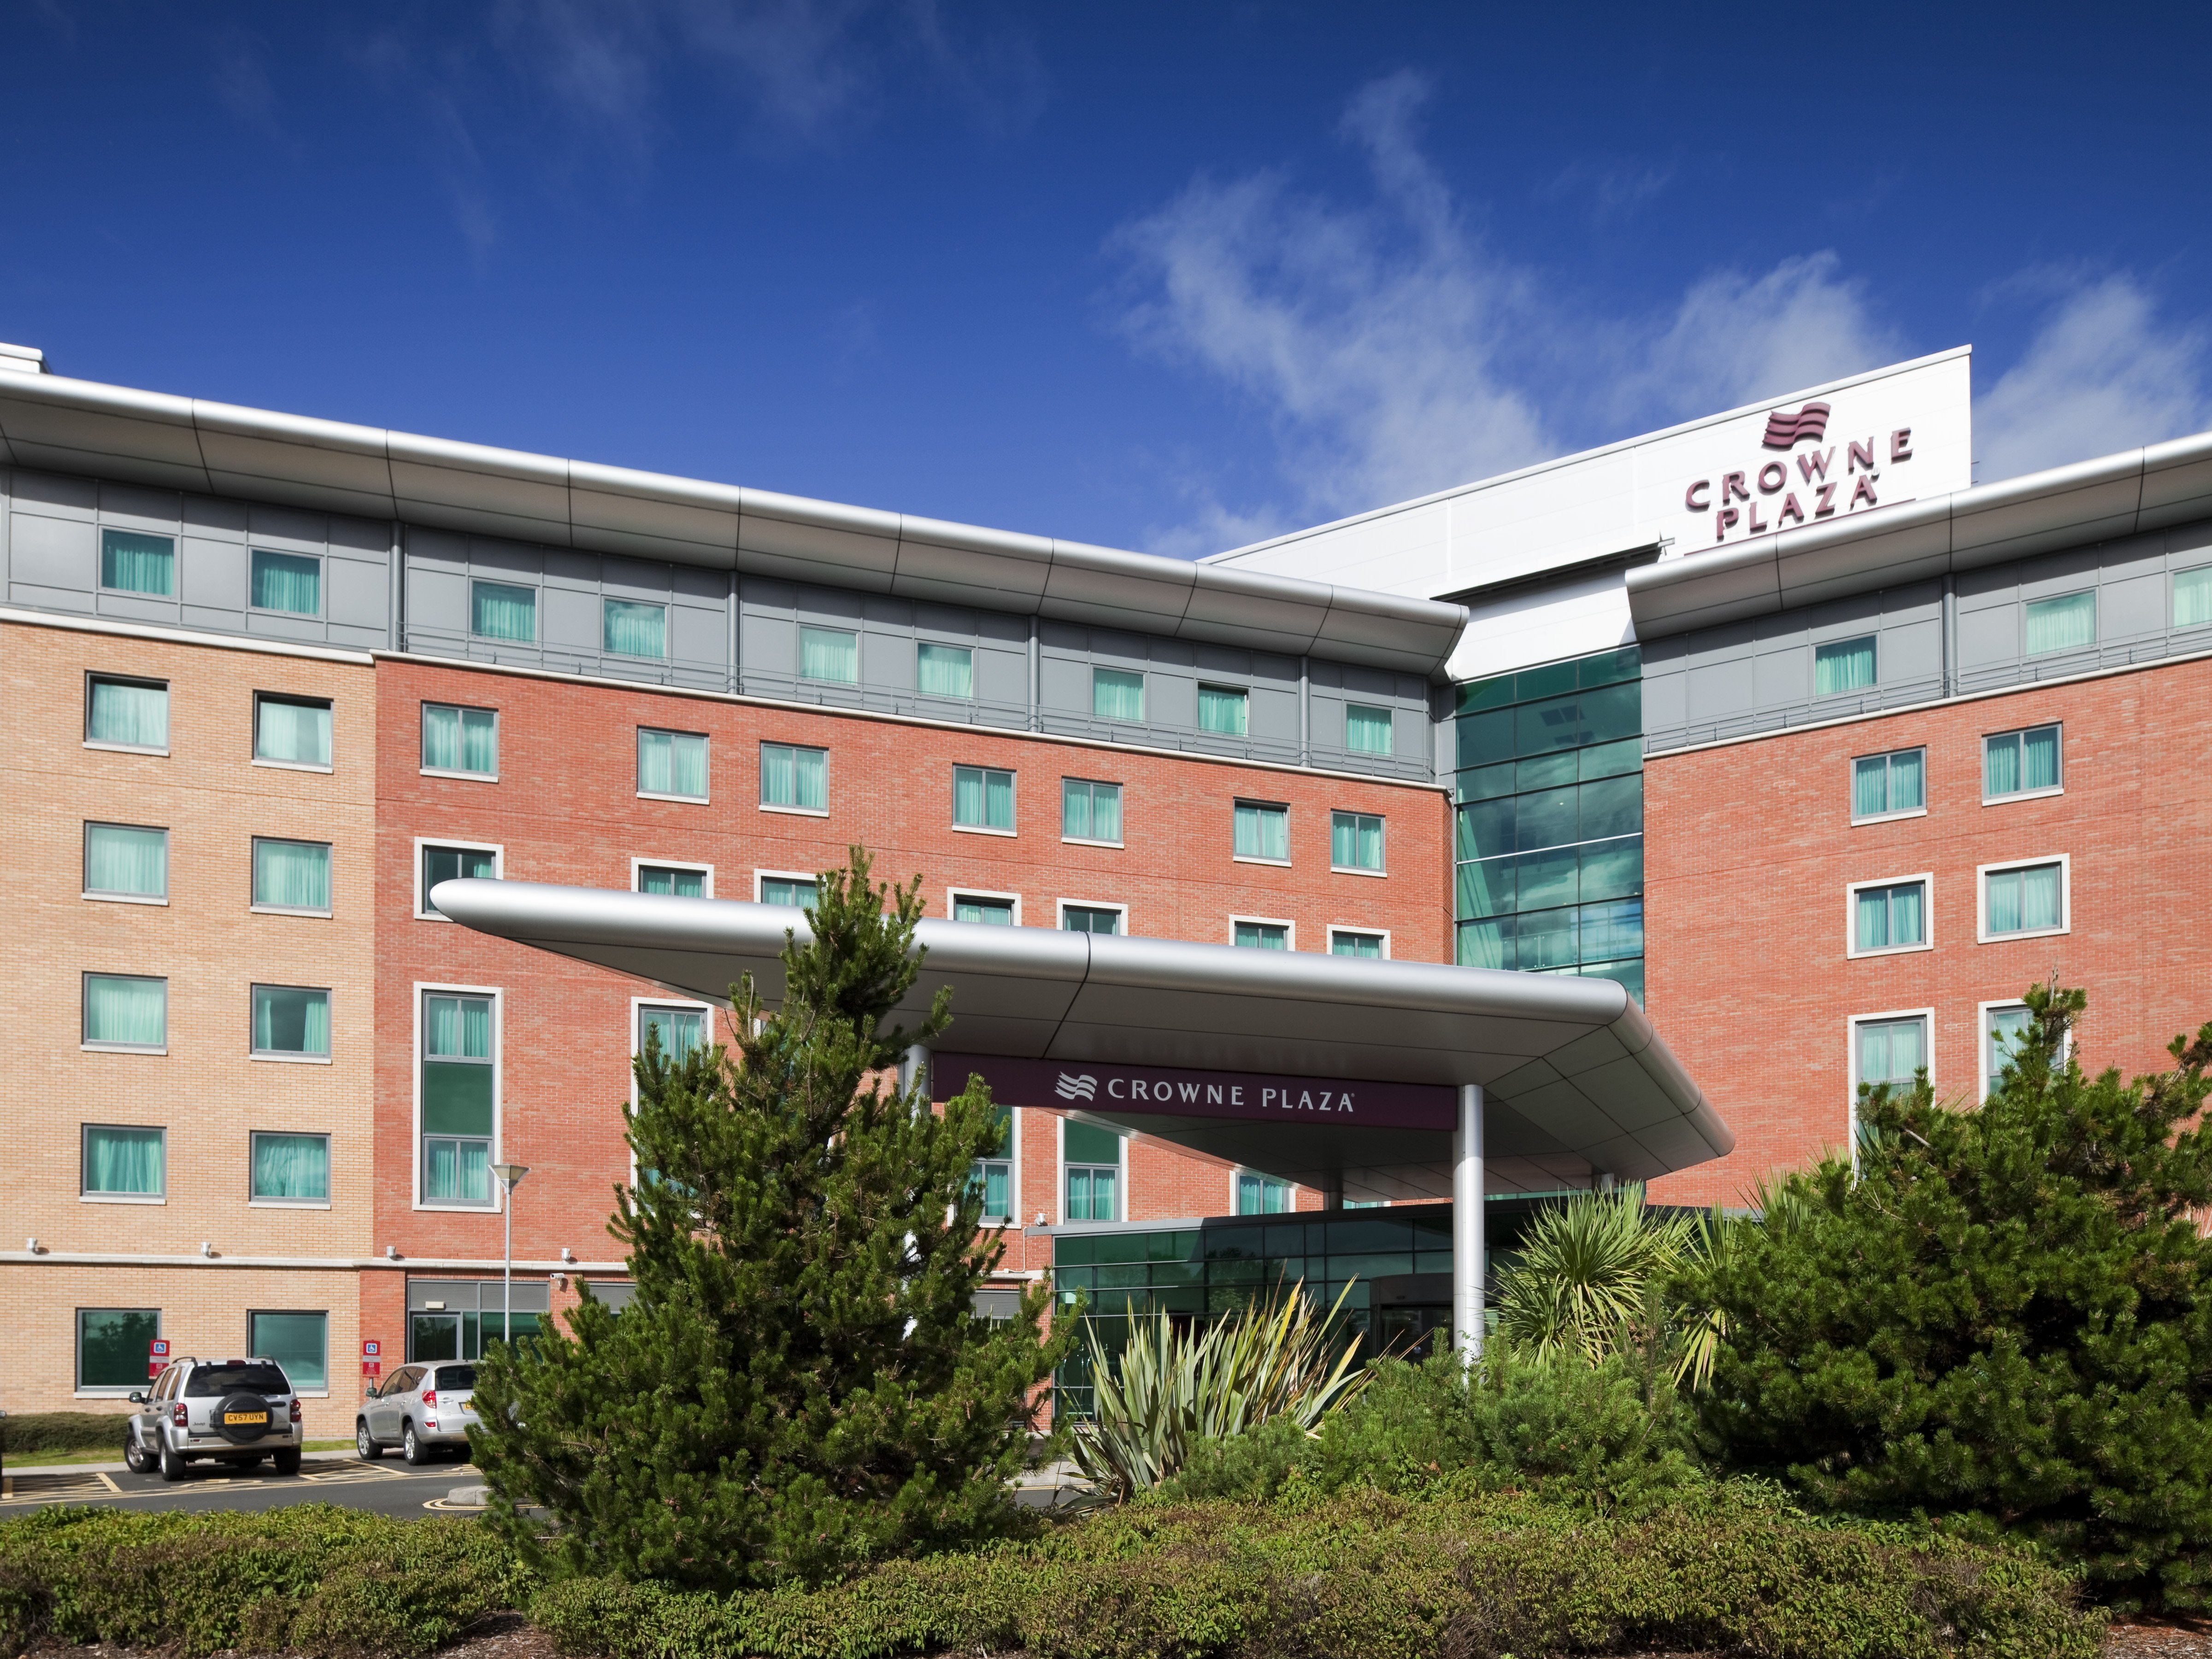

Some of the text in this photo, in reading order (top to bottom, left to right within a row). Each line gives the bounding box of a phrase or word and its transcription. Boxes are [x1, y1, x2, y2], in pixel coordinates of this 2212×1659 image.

[1685, 427, 1913, 512] CROWNE
[1717, 474, 1878, 541] PLAZA
[1107, 1078, 1245, 1106] CROWNE
